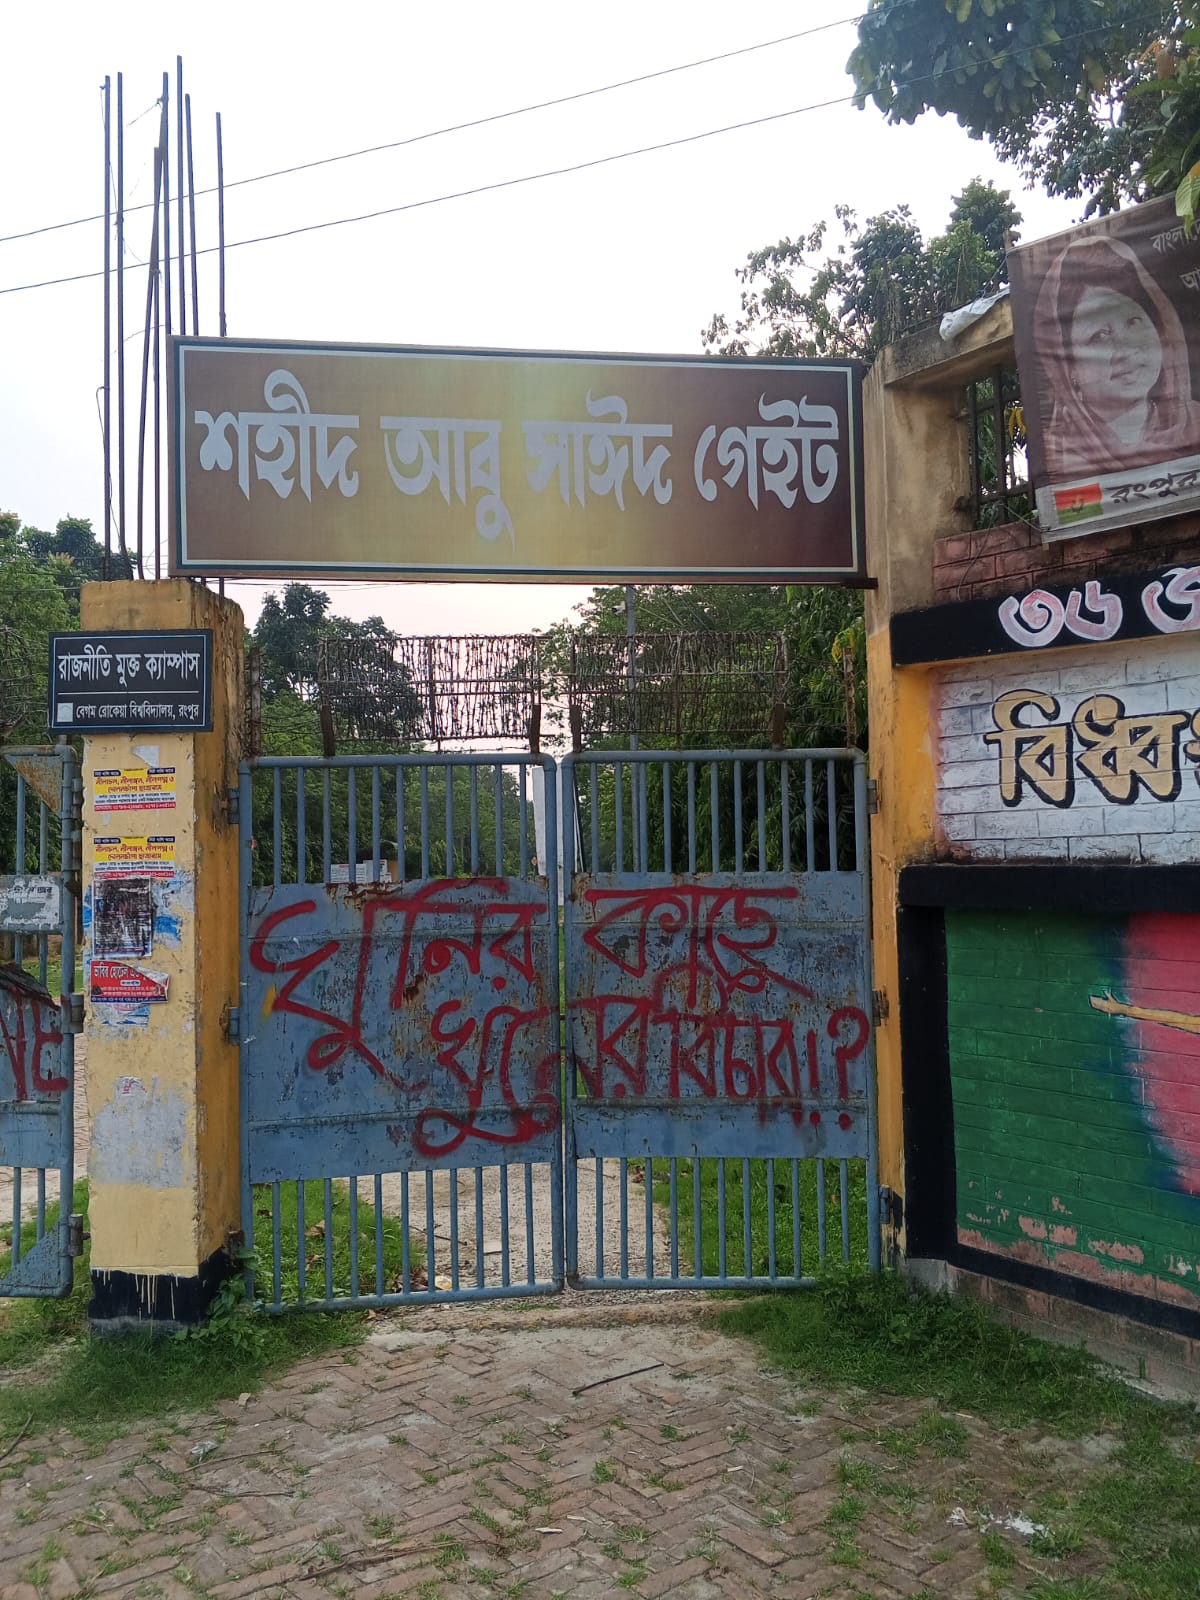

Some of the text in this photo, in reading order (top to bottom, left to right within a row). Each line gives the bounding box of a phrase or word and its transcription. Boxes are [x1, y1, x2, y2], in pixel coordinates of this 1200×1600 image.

[195, 369, 840, 550] শহীদ আবু সাঈদ গেইট
[57, 643, 201, 687] রাজনীতি মুক্ত ক্যাম্পাস
[76, 700, 199, 720] বেগম রোকেয়া বিশ্ববিদ্যালয়, রংপুর
